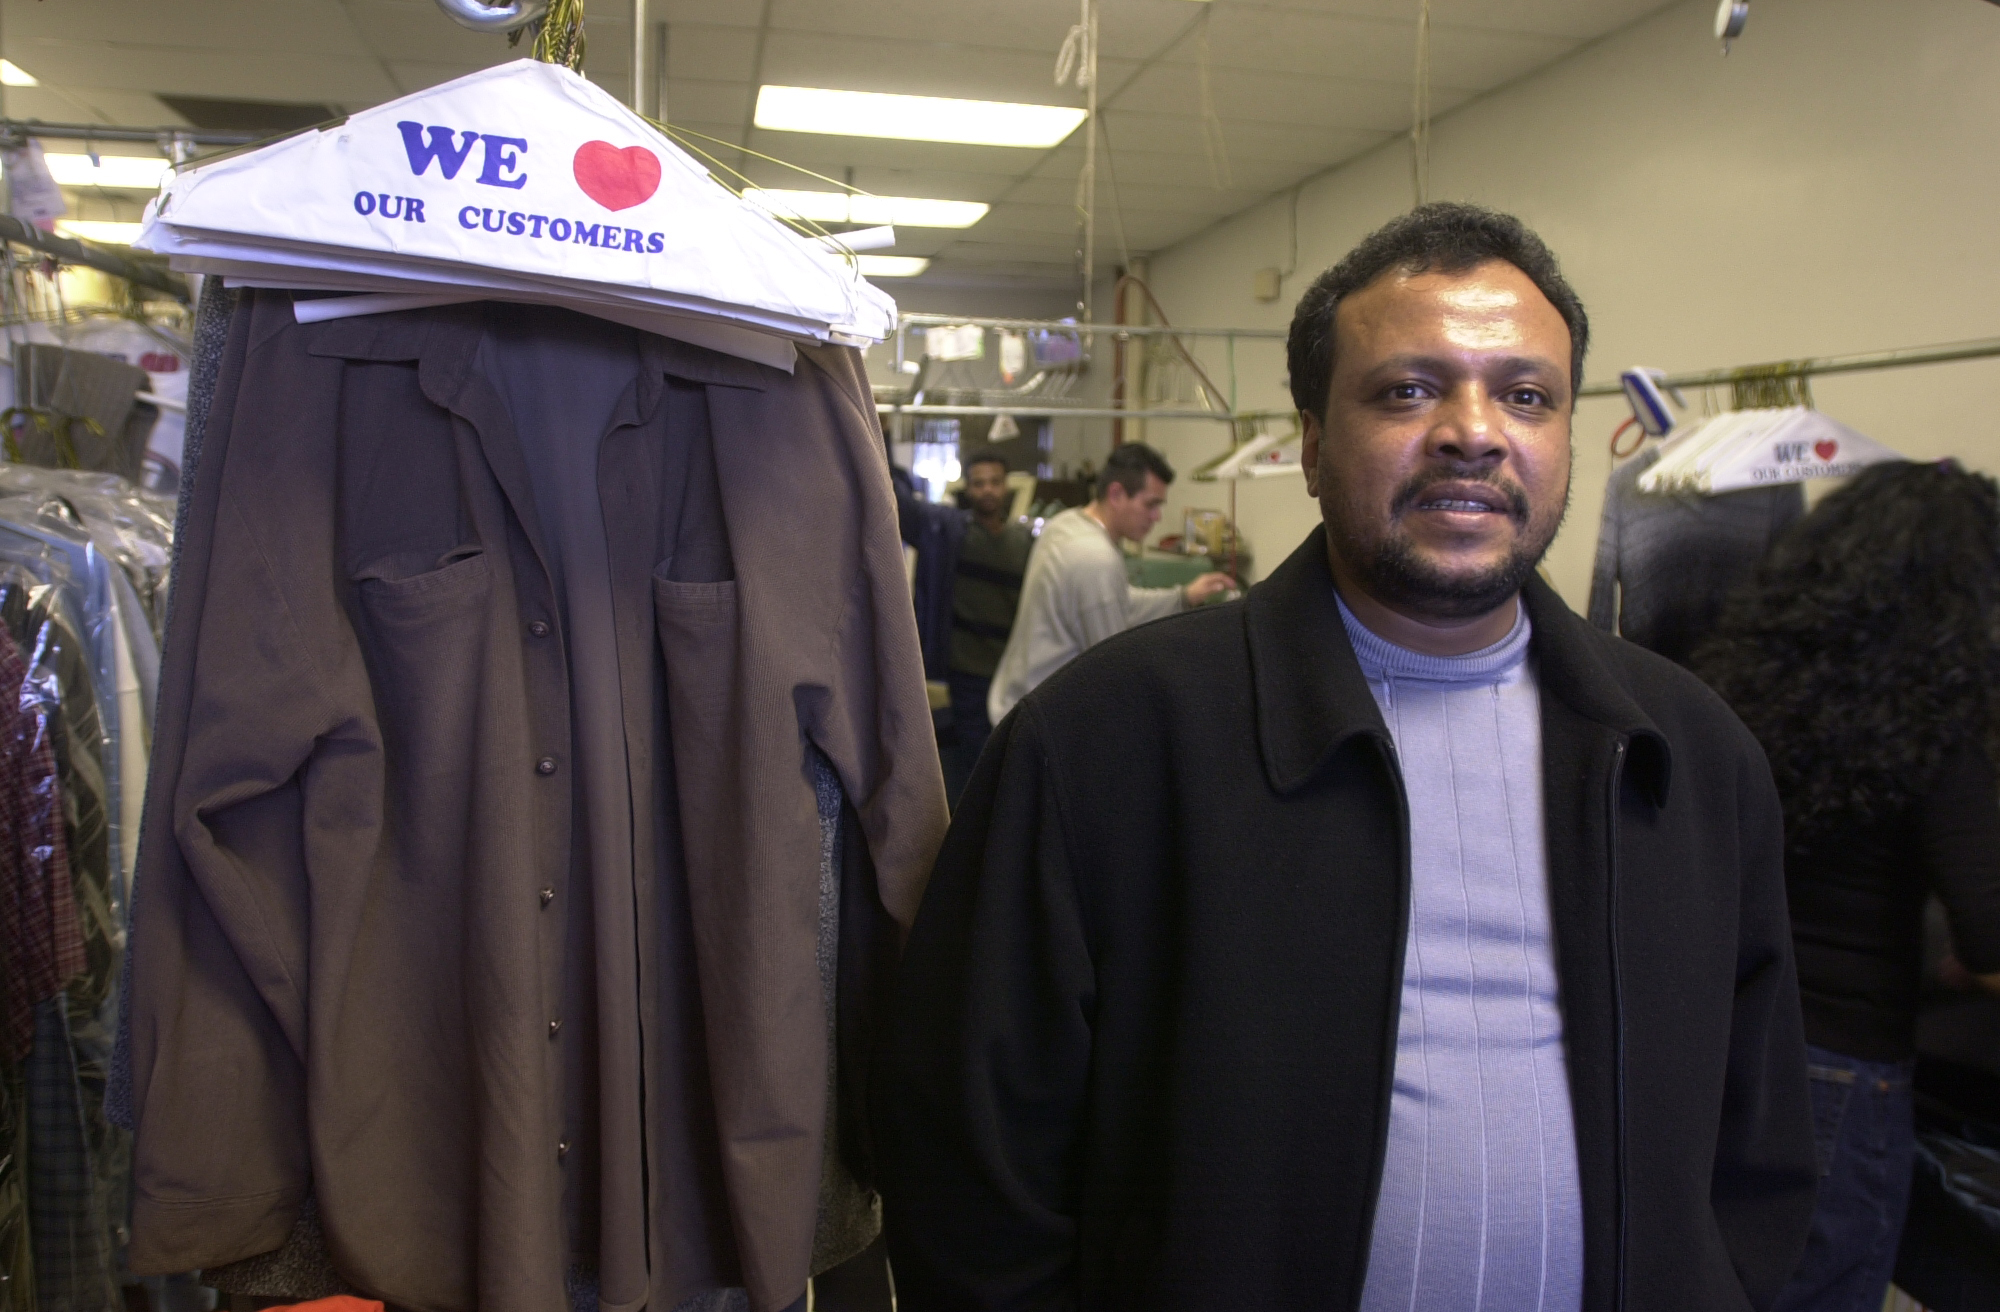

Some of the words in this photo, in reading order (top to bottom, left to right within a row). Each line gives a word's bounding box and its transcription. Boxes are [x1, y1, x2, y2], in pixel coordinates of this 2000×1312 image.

[397, 121, 528, 190] WE
[353, 191, 426, 224] OUR
[458, 206, 665, 254] CUSTOMERS
[1774, 441, 1809, 463] WE
